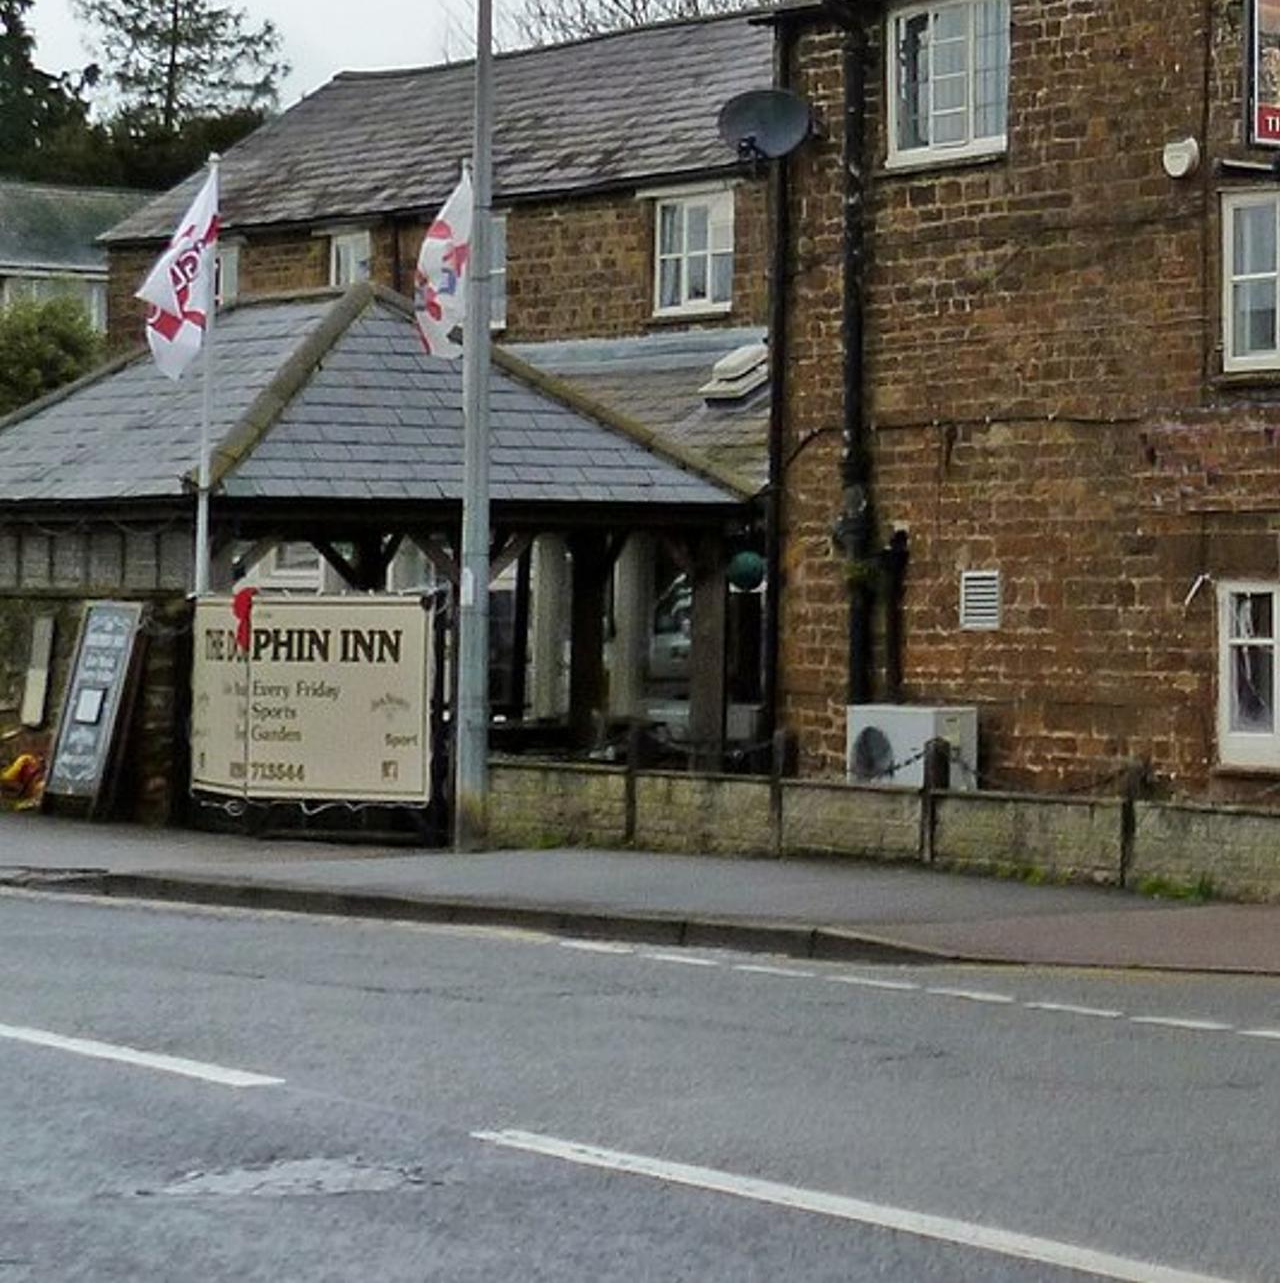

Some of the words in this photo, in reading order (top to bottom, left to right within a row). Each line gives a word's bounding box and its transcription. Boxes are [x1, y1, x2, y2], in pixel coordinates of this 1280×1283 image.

[339, 628, 403, 663] INN
[253, 680, 289, 701] Every
[296, 680, 340, 701] Friday
[251, 703, 297, 721] Sports
